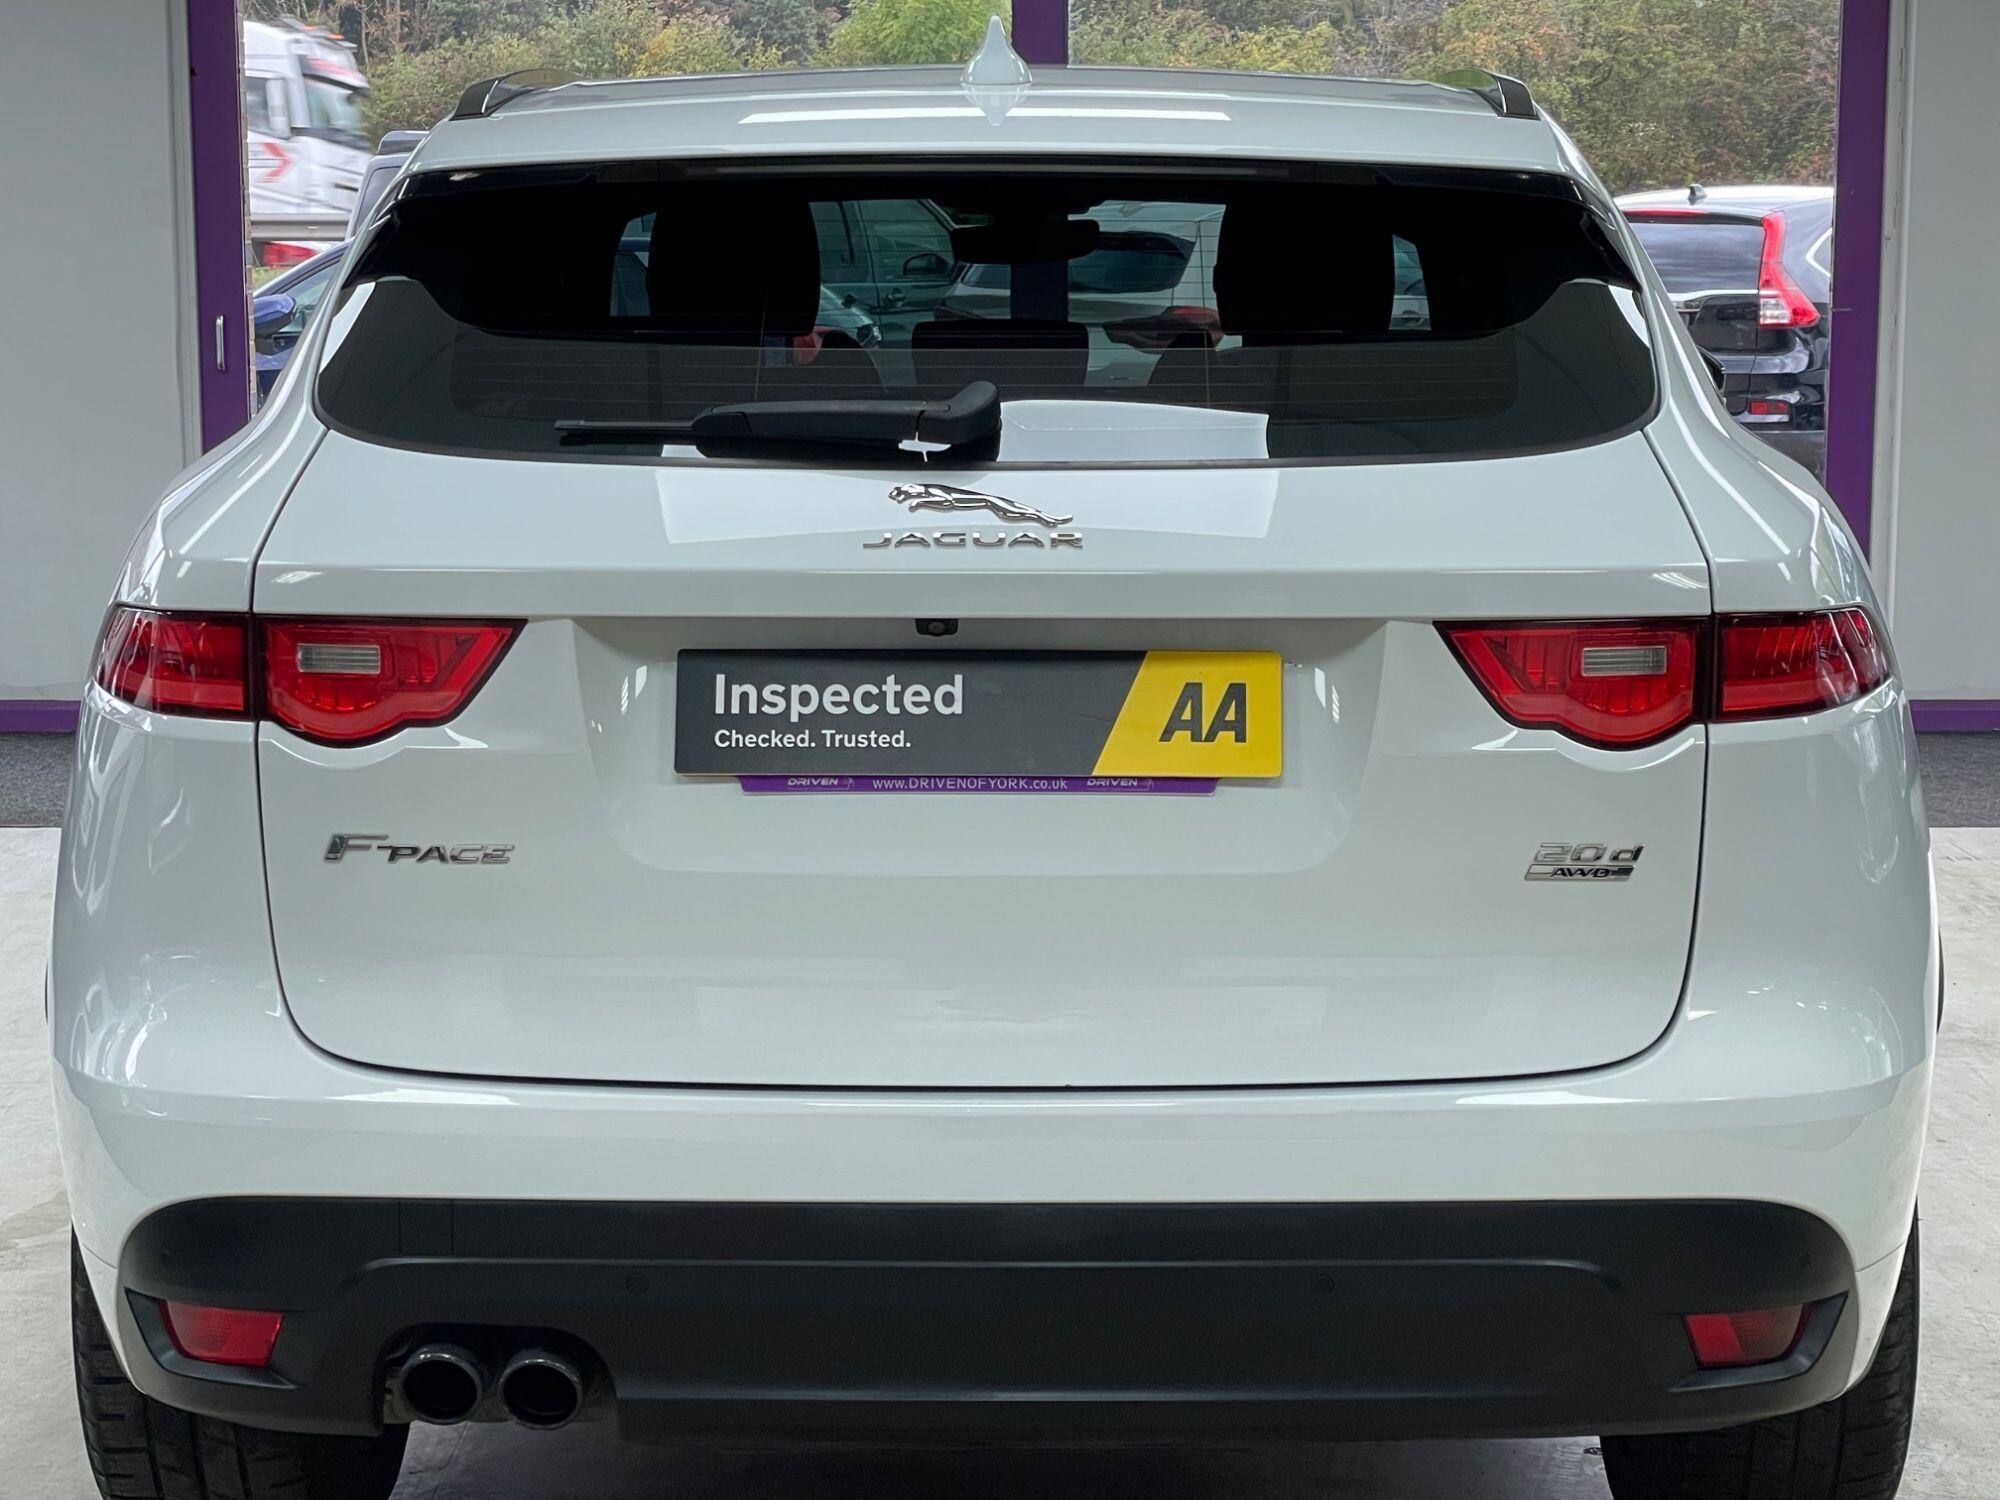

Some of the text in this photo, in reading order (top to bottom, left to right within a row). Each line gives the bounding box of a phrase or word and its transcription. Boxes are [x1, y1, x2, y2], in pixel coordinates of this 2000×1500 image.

[863, 532, 1083, 549] JAGUAR
[714, 673, 964, 722] Inspected
[1158, 682, 1248, 743] AA
[714, 729, 912, 748] Checked. Trusted.
[787, 777, 839, 786] DRIVEN
[872, 777, 1068, 790] www.DRIVENOFYORK.co.uk
[1086, 777, 1138, 786] DRIVEN
[1533, 842, 1646, 863] 20d
[1550, 867, 1610, 878] AWD
